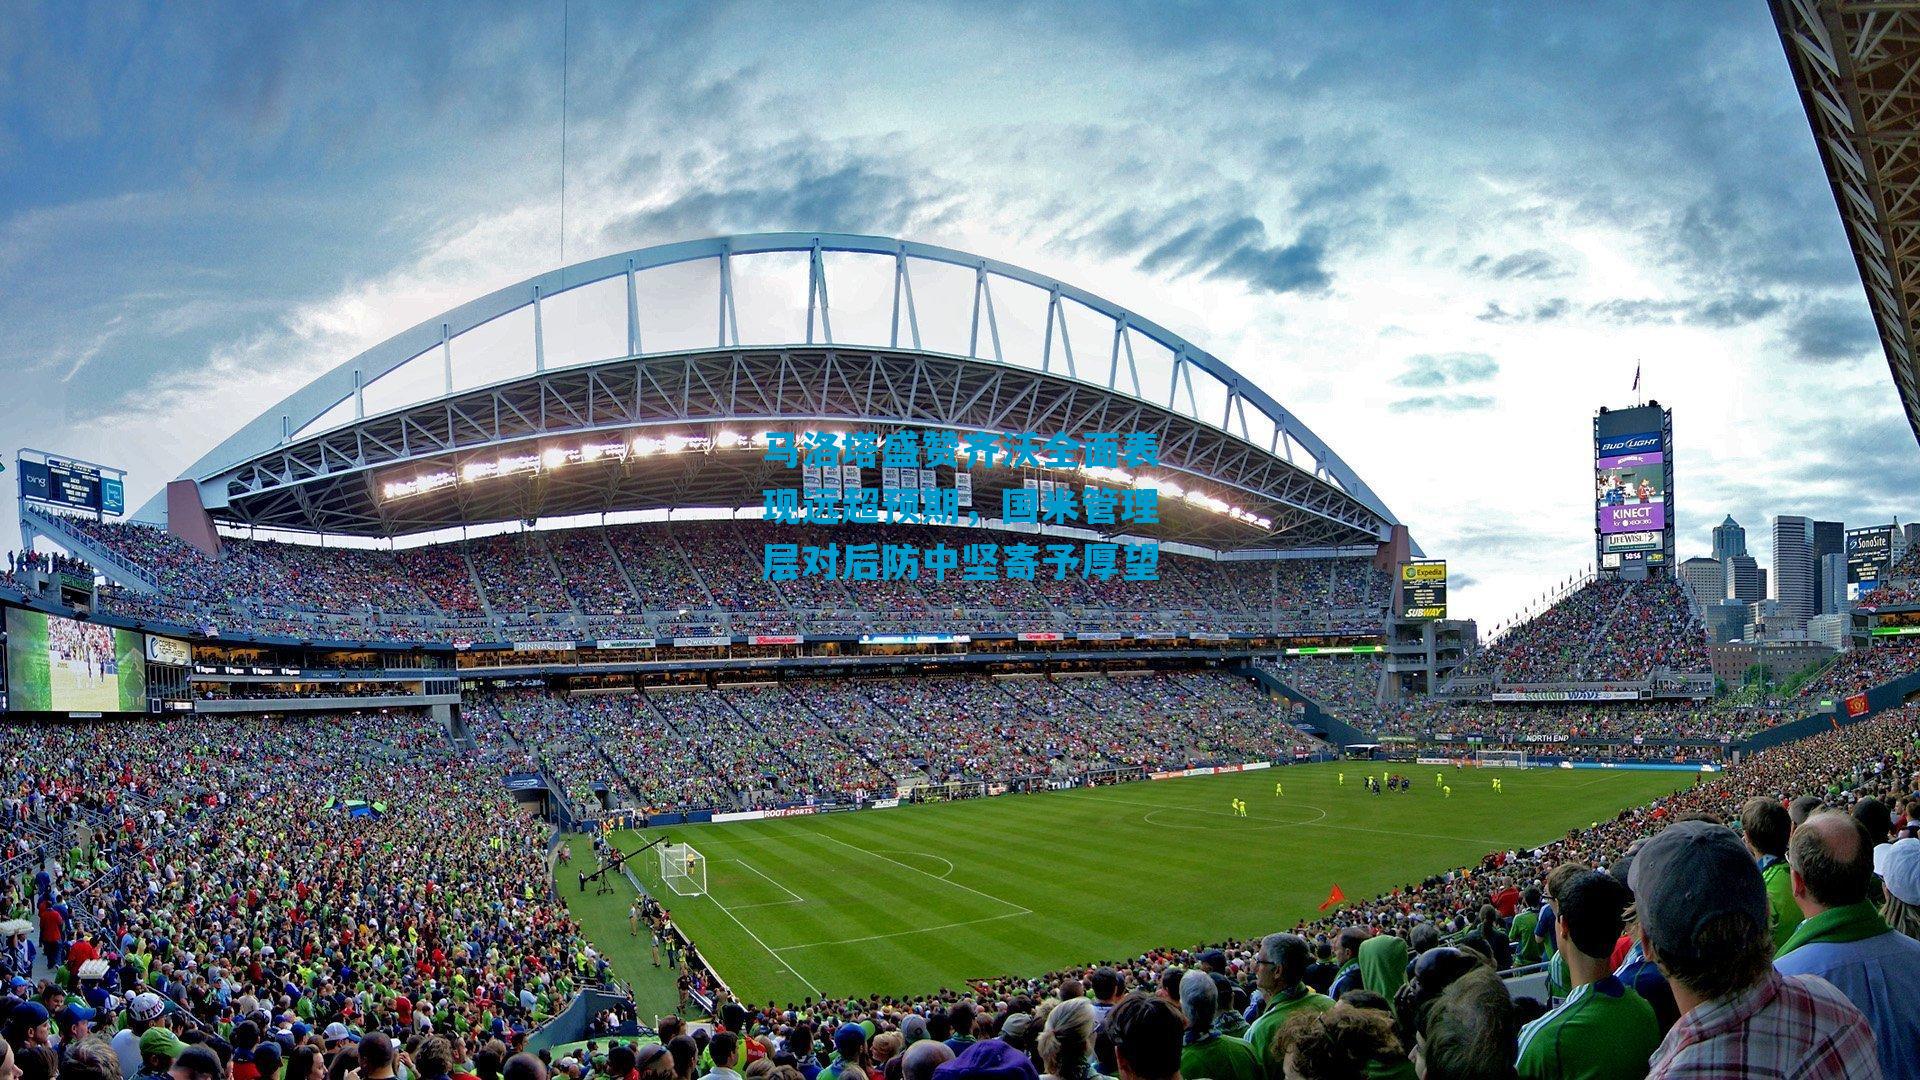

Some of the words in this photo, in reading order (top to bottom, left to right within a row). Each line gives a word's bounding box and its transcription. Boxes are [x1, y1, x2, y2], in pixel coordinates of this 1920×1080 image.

[1602, 441, 1625, 451] BUD
[26, 474, 46, 488] bing
[1613, 507, 1653, 519] KINECT
[1858, 536, 1886, 549] SonoSite
[1417, 569, 1442, 577] Expedia
[1405, 608, 1444, 617] SUBWAY
[518, 642, 564, 650] PINNACLE
[1554, 734, 1569, 742] END
[765, 809, 786, 817] ROOT
